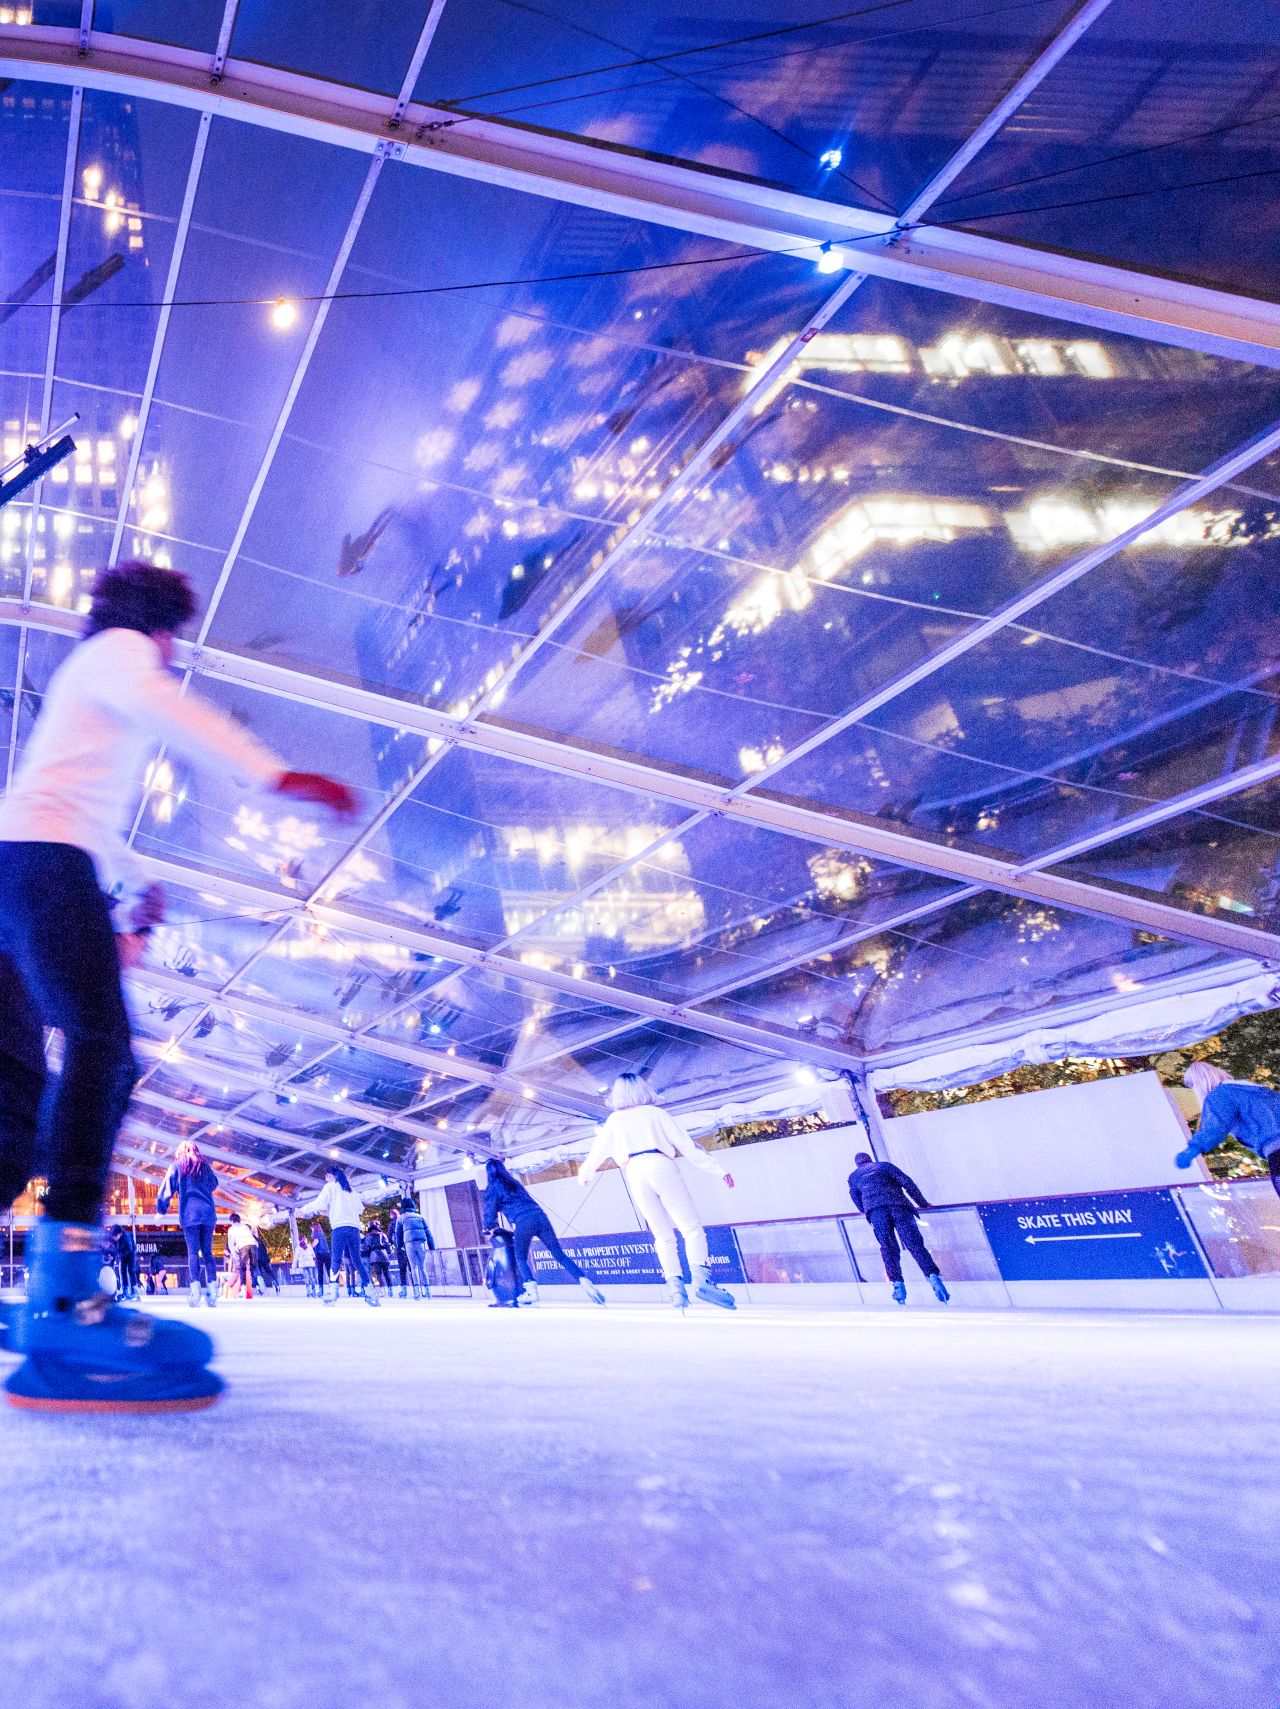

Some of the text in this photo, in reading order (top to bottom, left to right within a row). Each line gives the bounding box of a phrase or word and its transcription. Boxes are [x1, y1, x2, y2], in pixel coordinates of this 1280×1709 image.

[1017, 1209, 1133, 1230] SKATE THIS WAY
[582, 1245, 620, 1257] PROPERTY
[590, 1257, 617, 1268] SKATES
